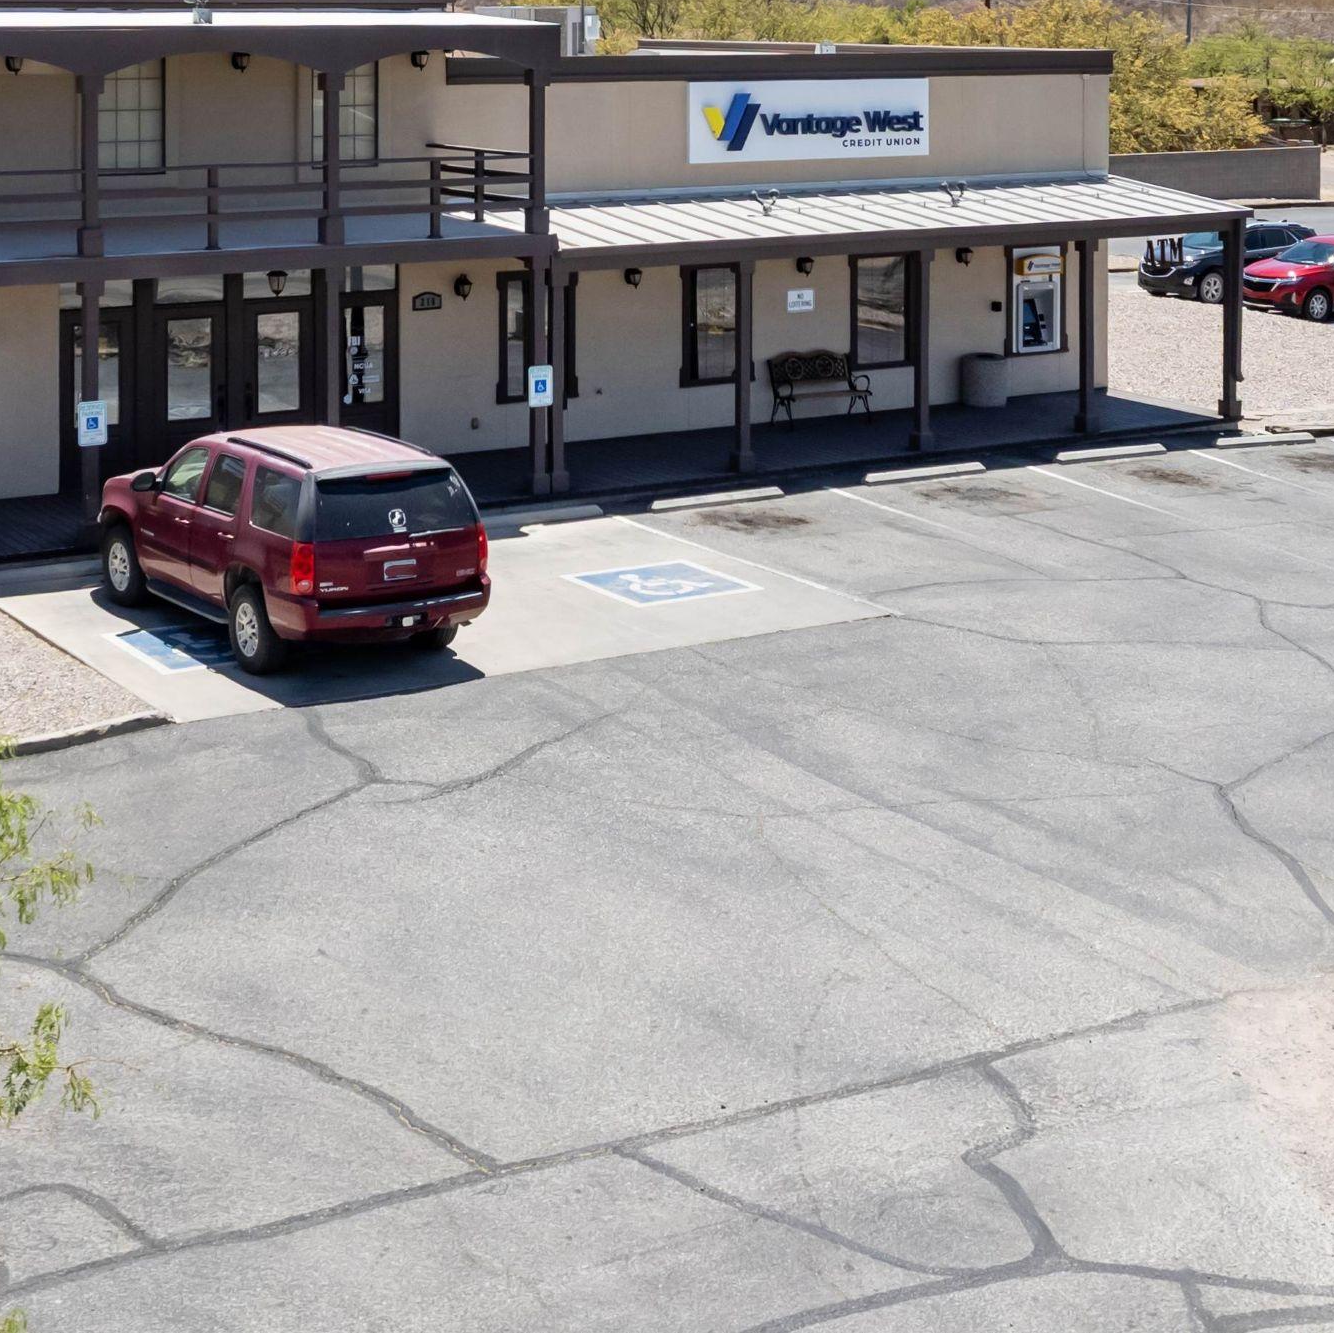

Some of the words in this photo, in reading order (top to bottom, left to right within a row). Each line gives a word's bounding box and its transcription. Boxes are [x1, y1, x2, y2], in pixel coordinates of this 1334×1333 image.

[760, 113, 862, 138] Vantage
[863, 110, 924, 133] West
[842, 139, 882, 147] CREDIT
[886, 137, 920, 146] UNION
[1144, 237, 1183, 266] ATM
